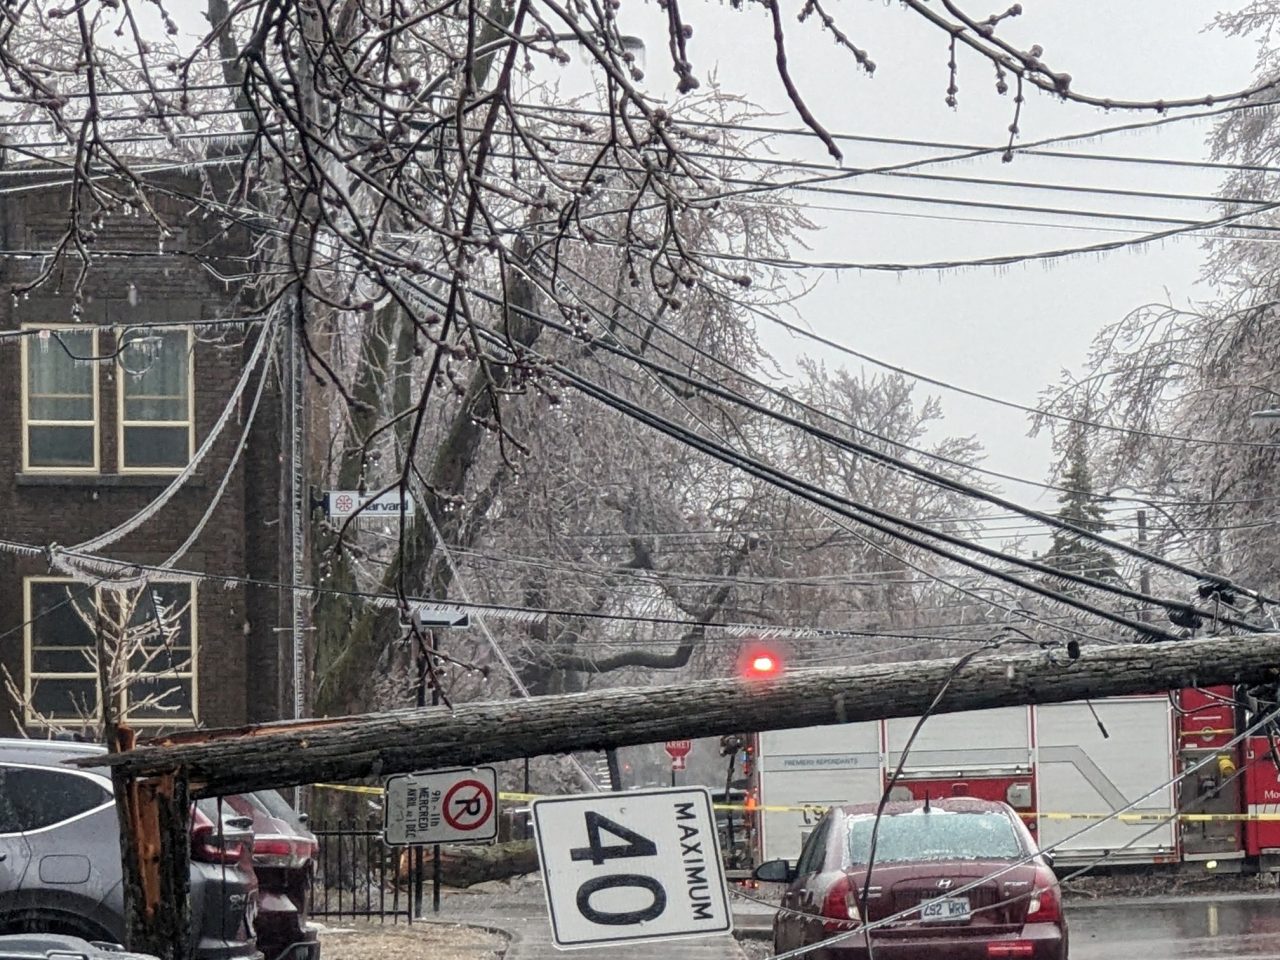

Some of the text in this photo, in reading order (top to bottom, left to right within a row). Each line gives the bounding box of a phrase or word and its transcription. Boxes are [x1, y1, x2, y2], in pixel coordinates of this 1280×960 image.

[406, 788, 417, 808] AVRIL
[418, 787, 429, 832] MERCREDI
[569, 811, 667, 926] 40
[674, 802, 714, 920] MAXIMUM
